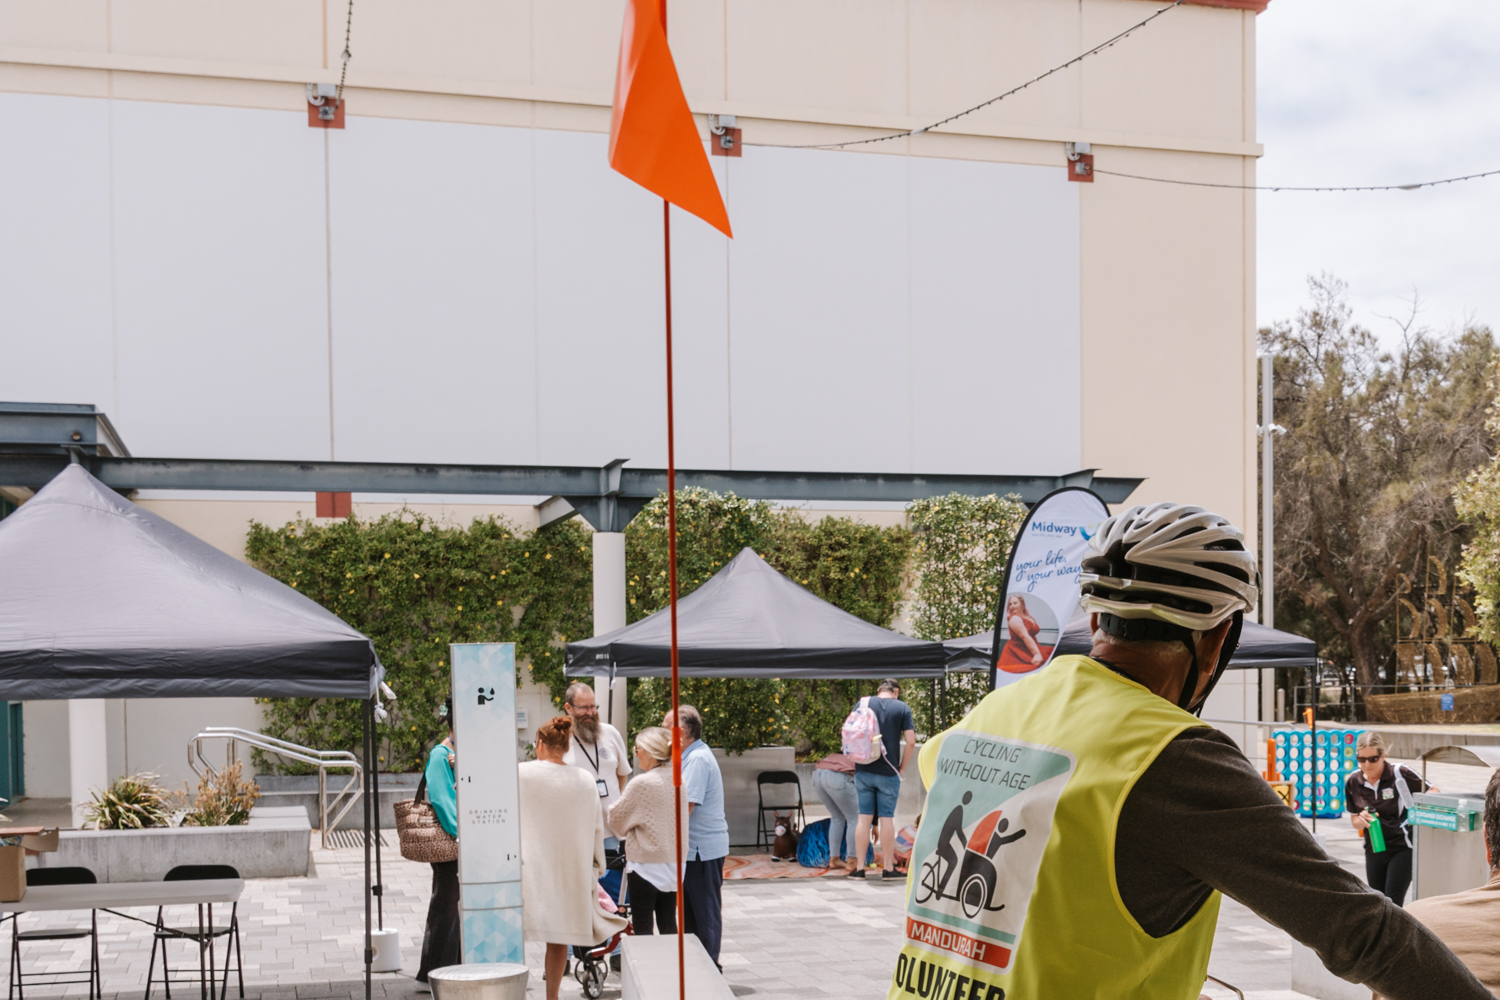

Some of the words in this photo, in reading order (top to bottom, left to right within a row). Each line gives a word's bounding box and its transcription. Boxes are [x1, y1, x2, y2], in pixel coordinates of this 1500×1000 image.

[1031, 521, 1077, 537] Midway
[1015, 559, 1043, 582] your
[1027, 570, 1054, 593] your
[963, 738, 1022, 763] CYCLING
[940, 757, 1002, 785] WITHOUT
[999, 770, 1031, 790] AGE
[910, 922, 987, 961] MANDURAH
